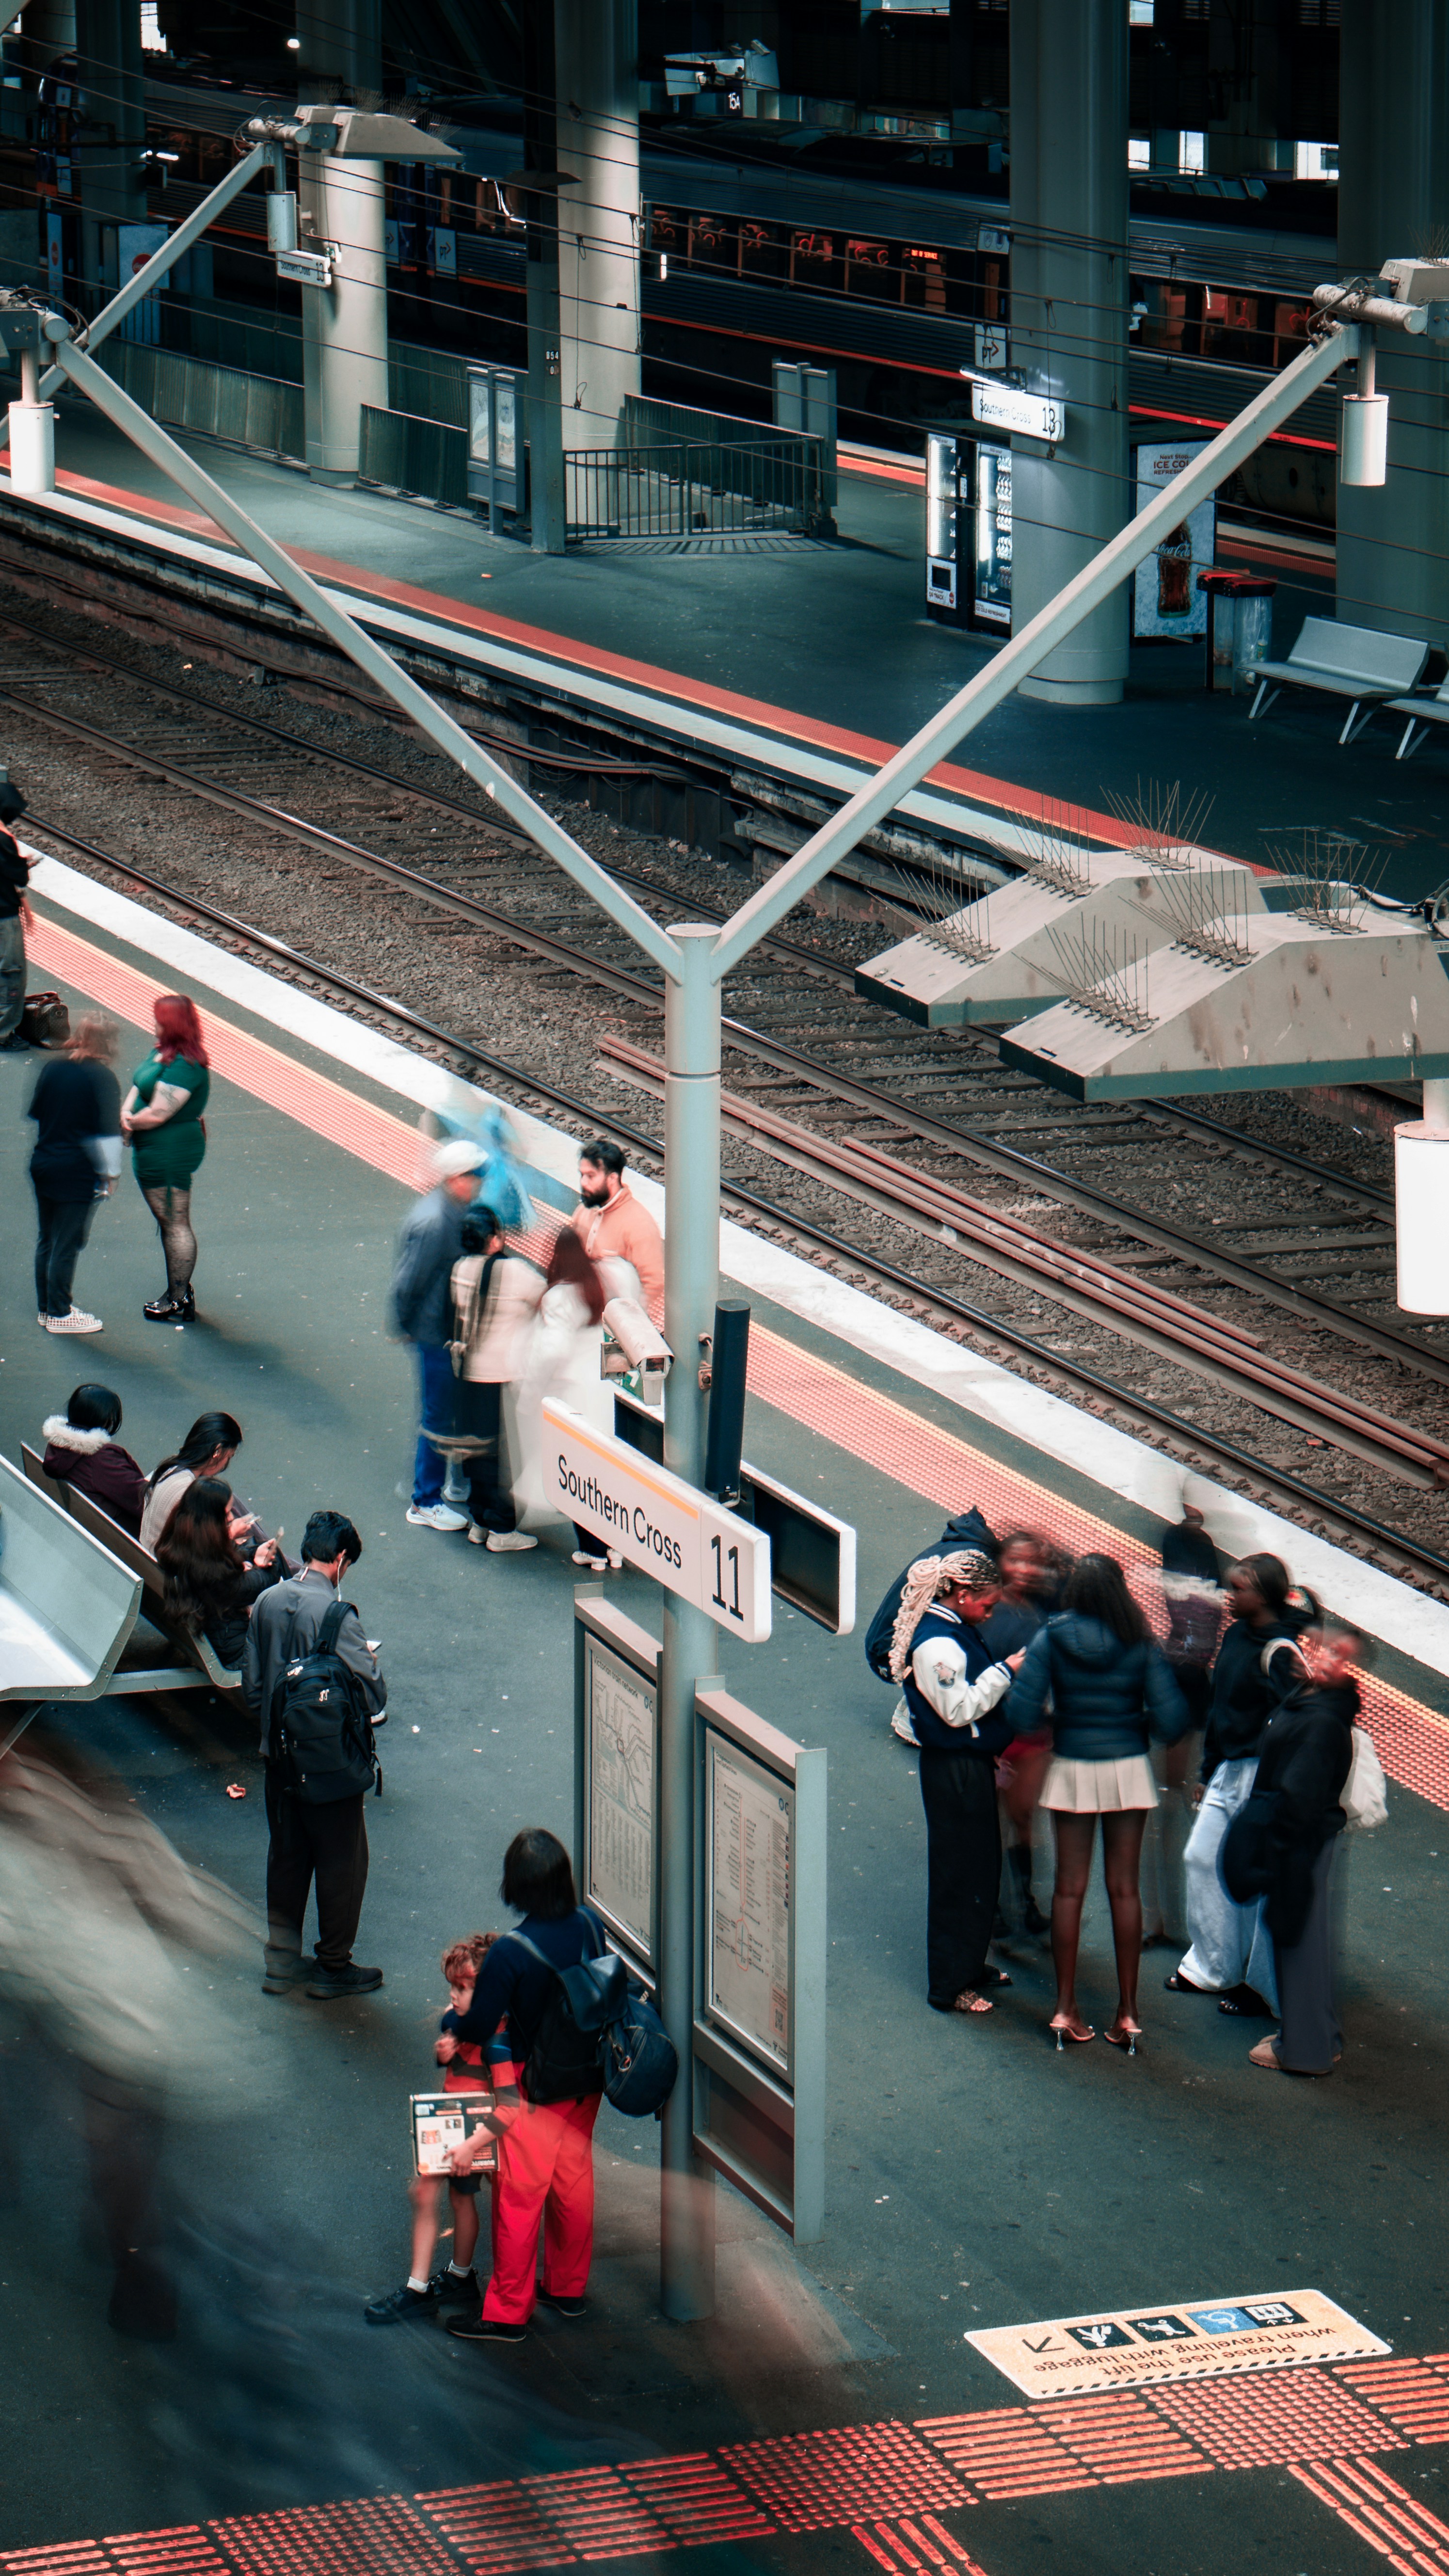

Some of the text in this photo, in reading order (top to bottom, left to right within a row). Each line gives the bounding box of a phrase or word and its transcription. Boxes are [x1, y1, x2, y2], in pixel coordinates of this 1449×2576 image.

[980, 399, 1056, 433] Southern Cross 13
[1154, 460, 1189, 469] ICE COL
[558, 1454, 743, 1621] Southern Cross 11
[594, 1655, 638, 1699] Victorian train network
[1033, 2328, 1337, 2371] when travelling with luggage
[1099, 2344, 1297, 2375] Please use the lift
